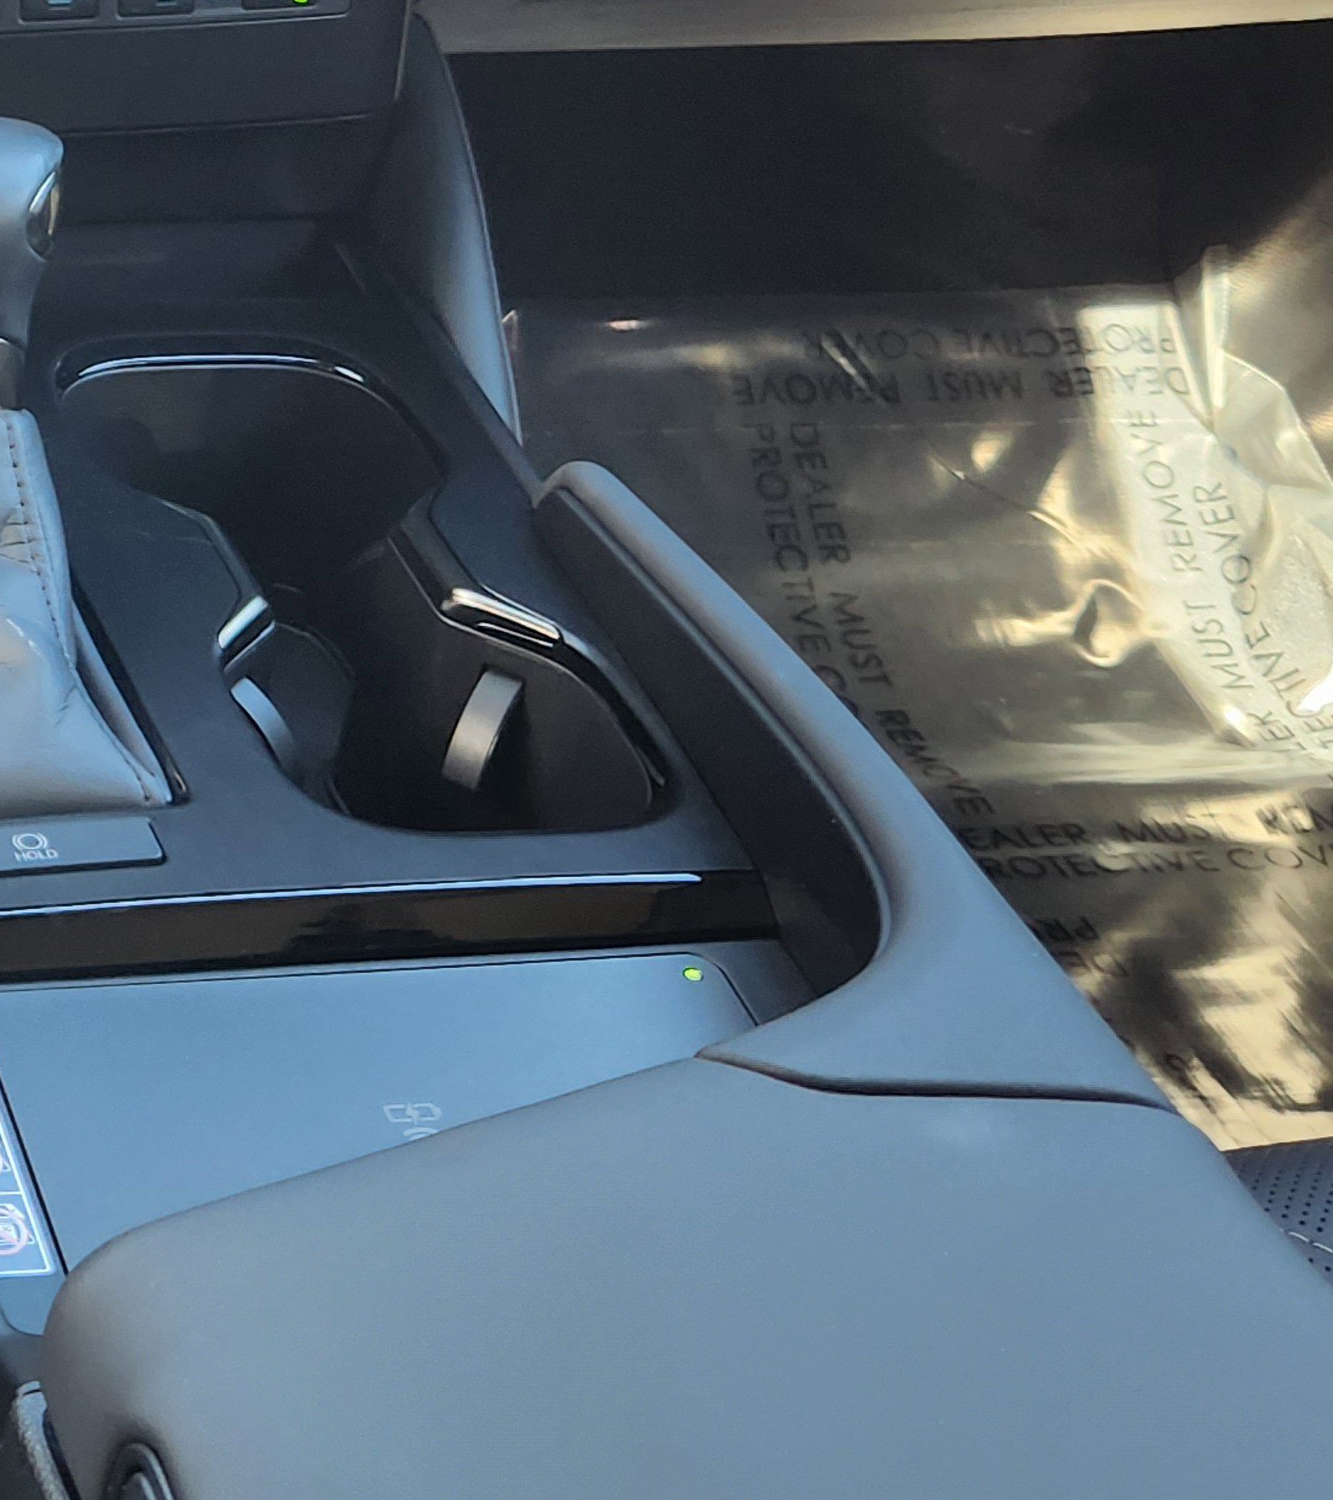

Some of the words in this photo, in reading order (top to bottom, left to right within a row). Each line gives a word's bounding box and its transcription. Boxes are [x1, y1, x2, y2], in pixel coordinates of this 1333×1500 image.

[926, 368, 1023, 401] MUST
[1131, 409, 1203, 574] REMOVE
[789, 422, 851, 565] DEALER
[829, 591, 894, 687] MUST
[1193, 482, 1260, 616] COVER
[1184, 599, 1254, 690] MUST
[14, 849, 60, 863] HOLD
[958, 821, 1089, 851] EALER
